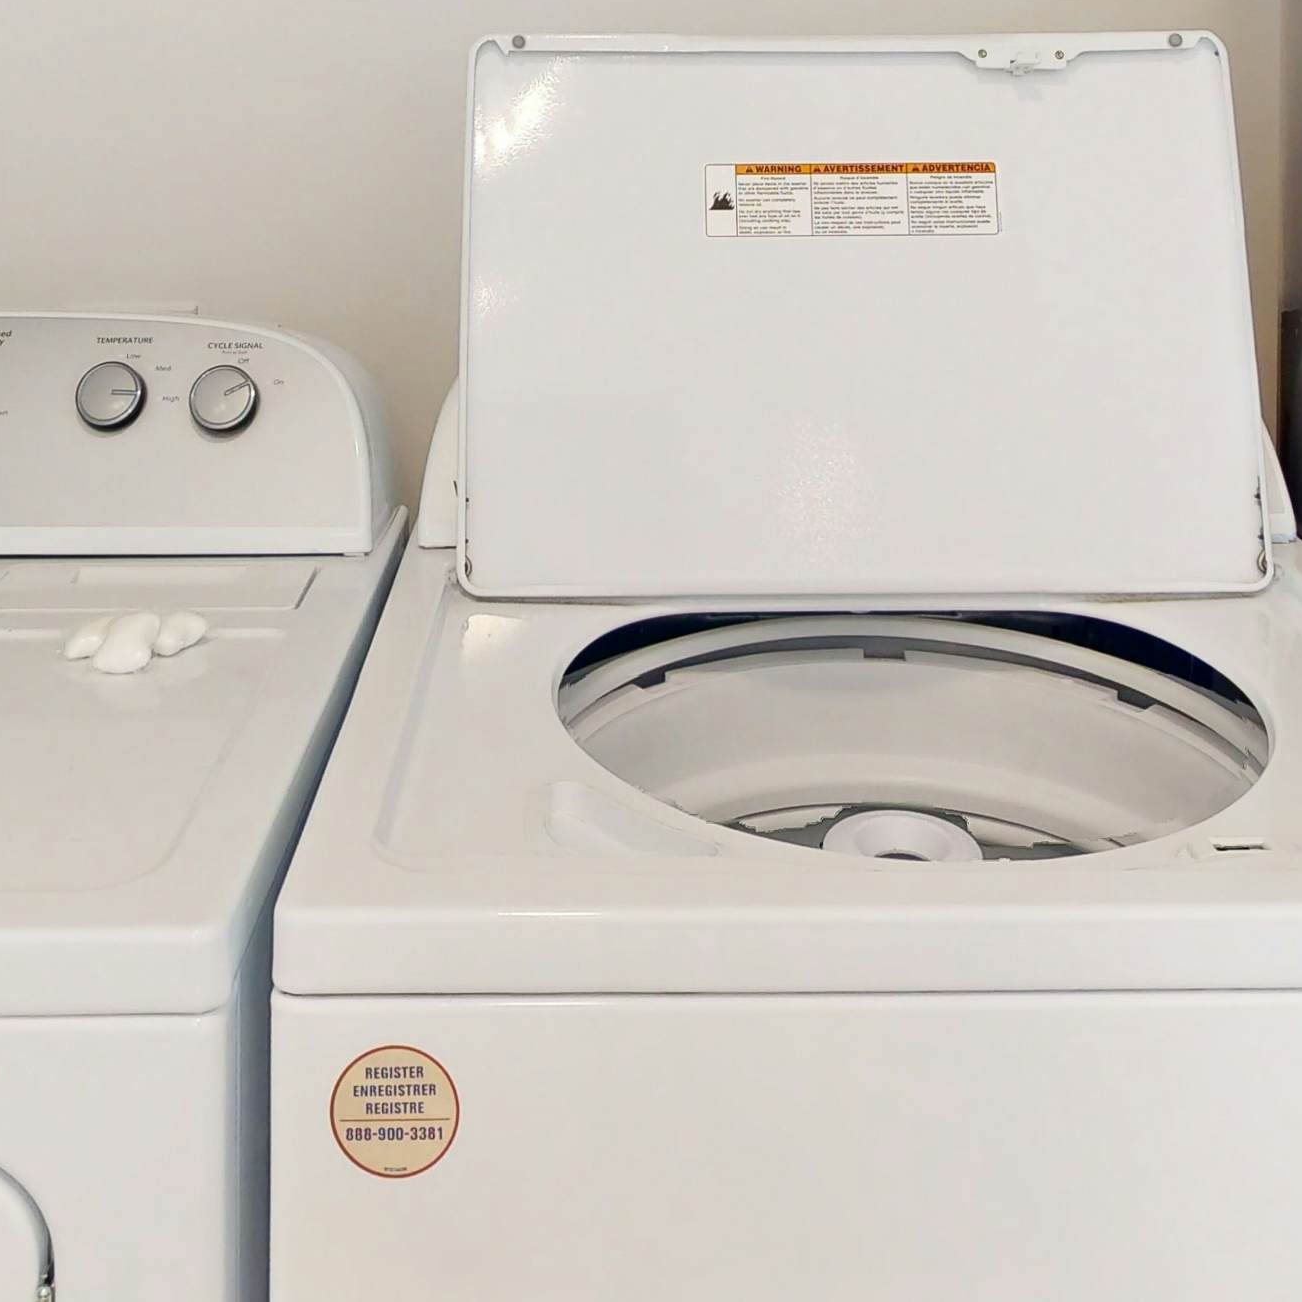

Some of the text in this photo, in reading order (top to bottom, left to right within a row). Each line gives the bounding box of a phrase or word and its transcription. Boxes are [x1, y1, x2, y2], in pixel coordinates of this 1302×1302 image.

[754, 165, 802, 173] WARNING
[823, 164, 904, 173] AVERTISSEMENT
[921, 163, 991, 172] ADVERTENCIA
[96, 336, 154, 345] TEMPERATURE
[207, 341, 263, 350] CYCLE SIGNAL
[273, 378, 285, 386] On
[365, 1065, 425, 1080] REGISTER
[353, 1083, 437, 1098] ENREGISTRER
[365, 1101, 425, 1115] REGISTRE
